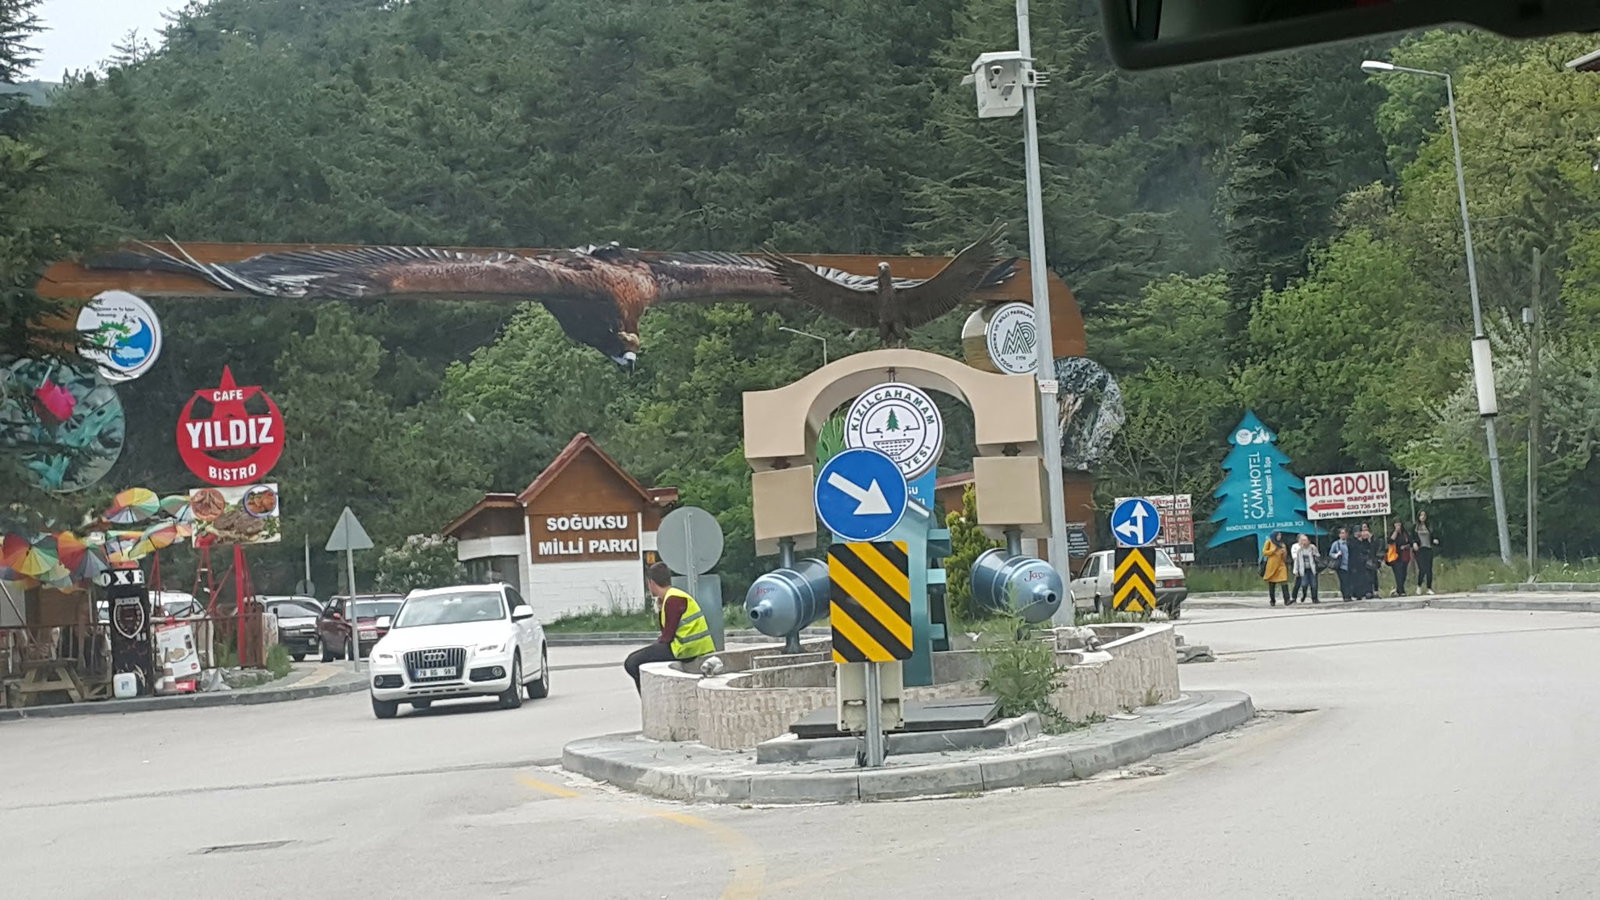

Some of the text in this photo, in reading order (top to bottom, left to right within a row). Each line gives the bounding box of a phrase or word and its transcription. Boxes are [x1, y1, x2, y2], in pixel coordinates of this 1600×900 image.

[213, 390, 244, 402] CAFE
[851, 390, 935, 431] KIZILCAHAMAM
[185, 417, 274, 449] YILDIZ
[546, 514, 628, 531] SOĞUKSU
[538, 537, 638, 556] MİLLİ PARKI
